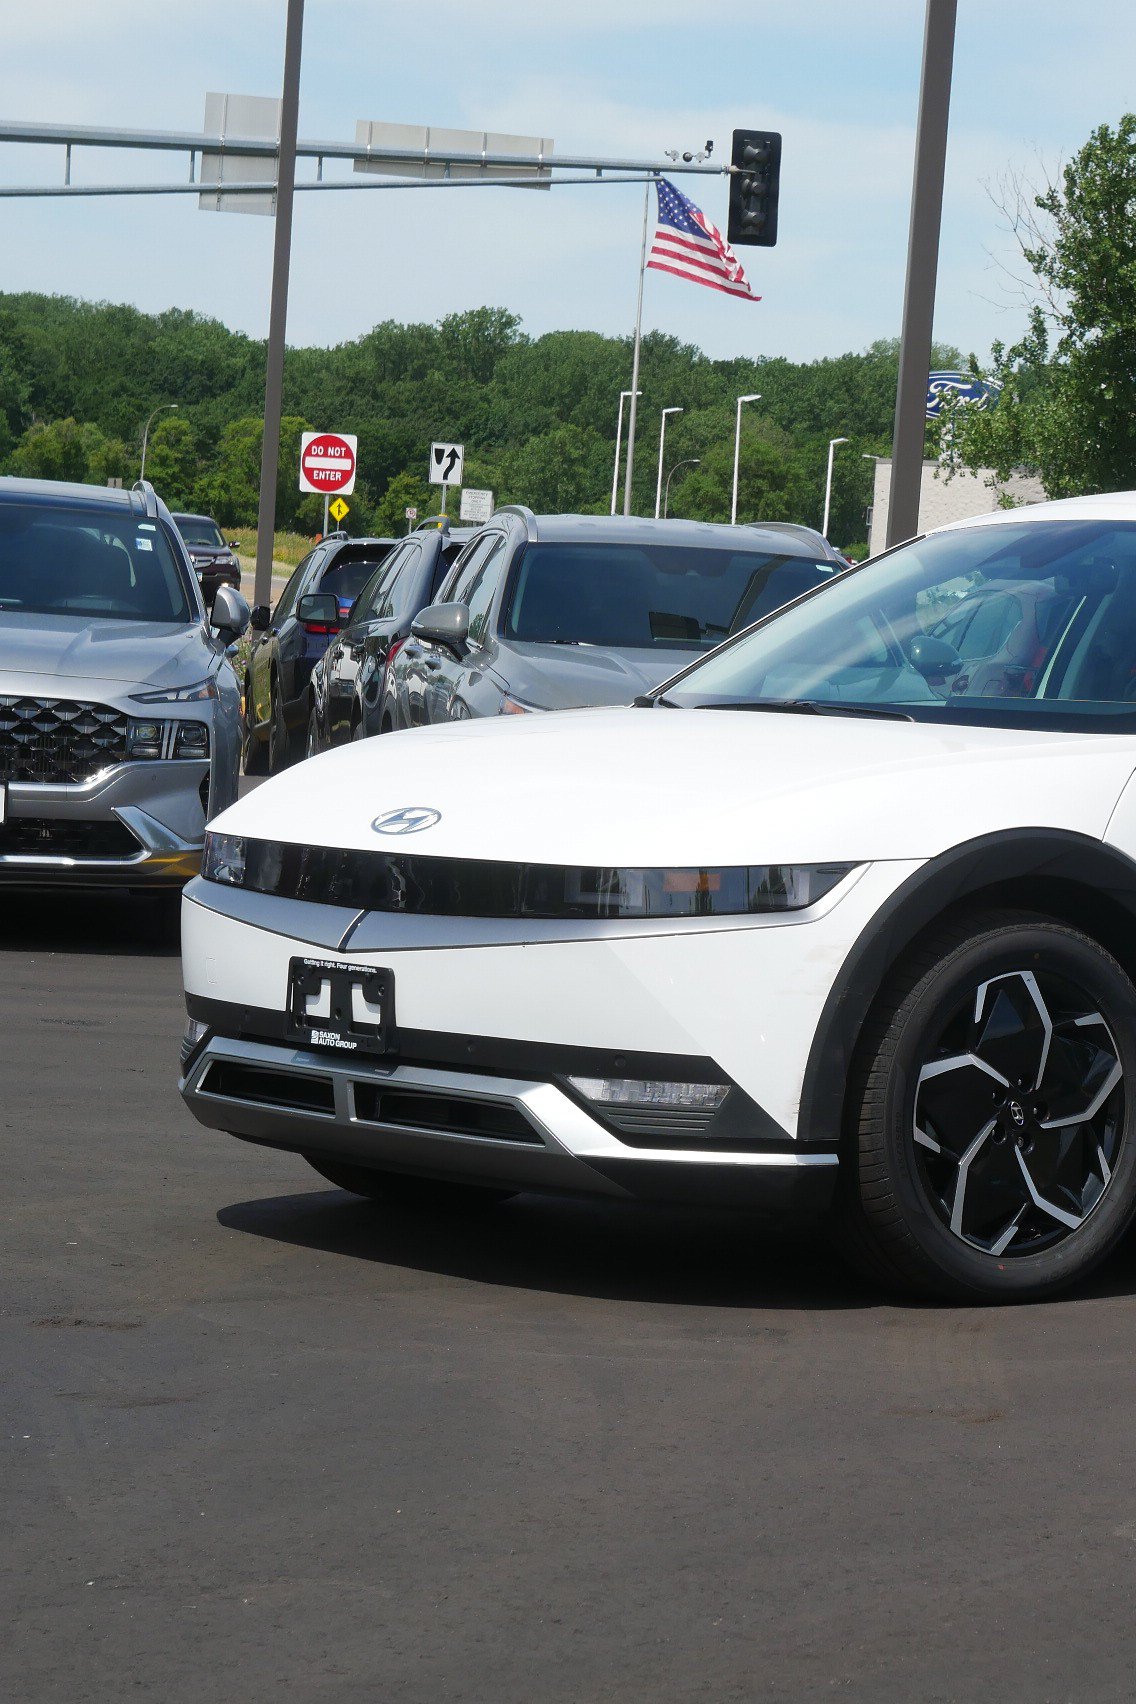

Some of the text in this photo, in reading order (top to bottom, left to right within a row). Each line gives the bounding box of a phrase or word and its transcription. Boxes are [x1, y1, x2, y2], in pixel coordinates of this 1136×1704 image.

[311, 445, 346, 457] DO NOT
[313, 471, 342, 481] ENTER
[319, 1031, 340, 1040] SAXON
[318, 1038, 357, 1049] AUTO GROUP
